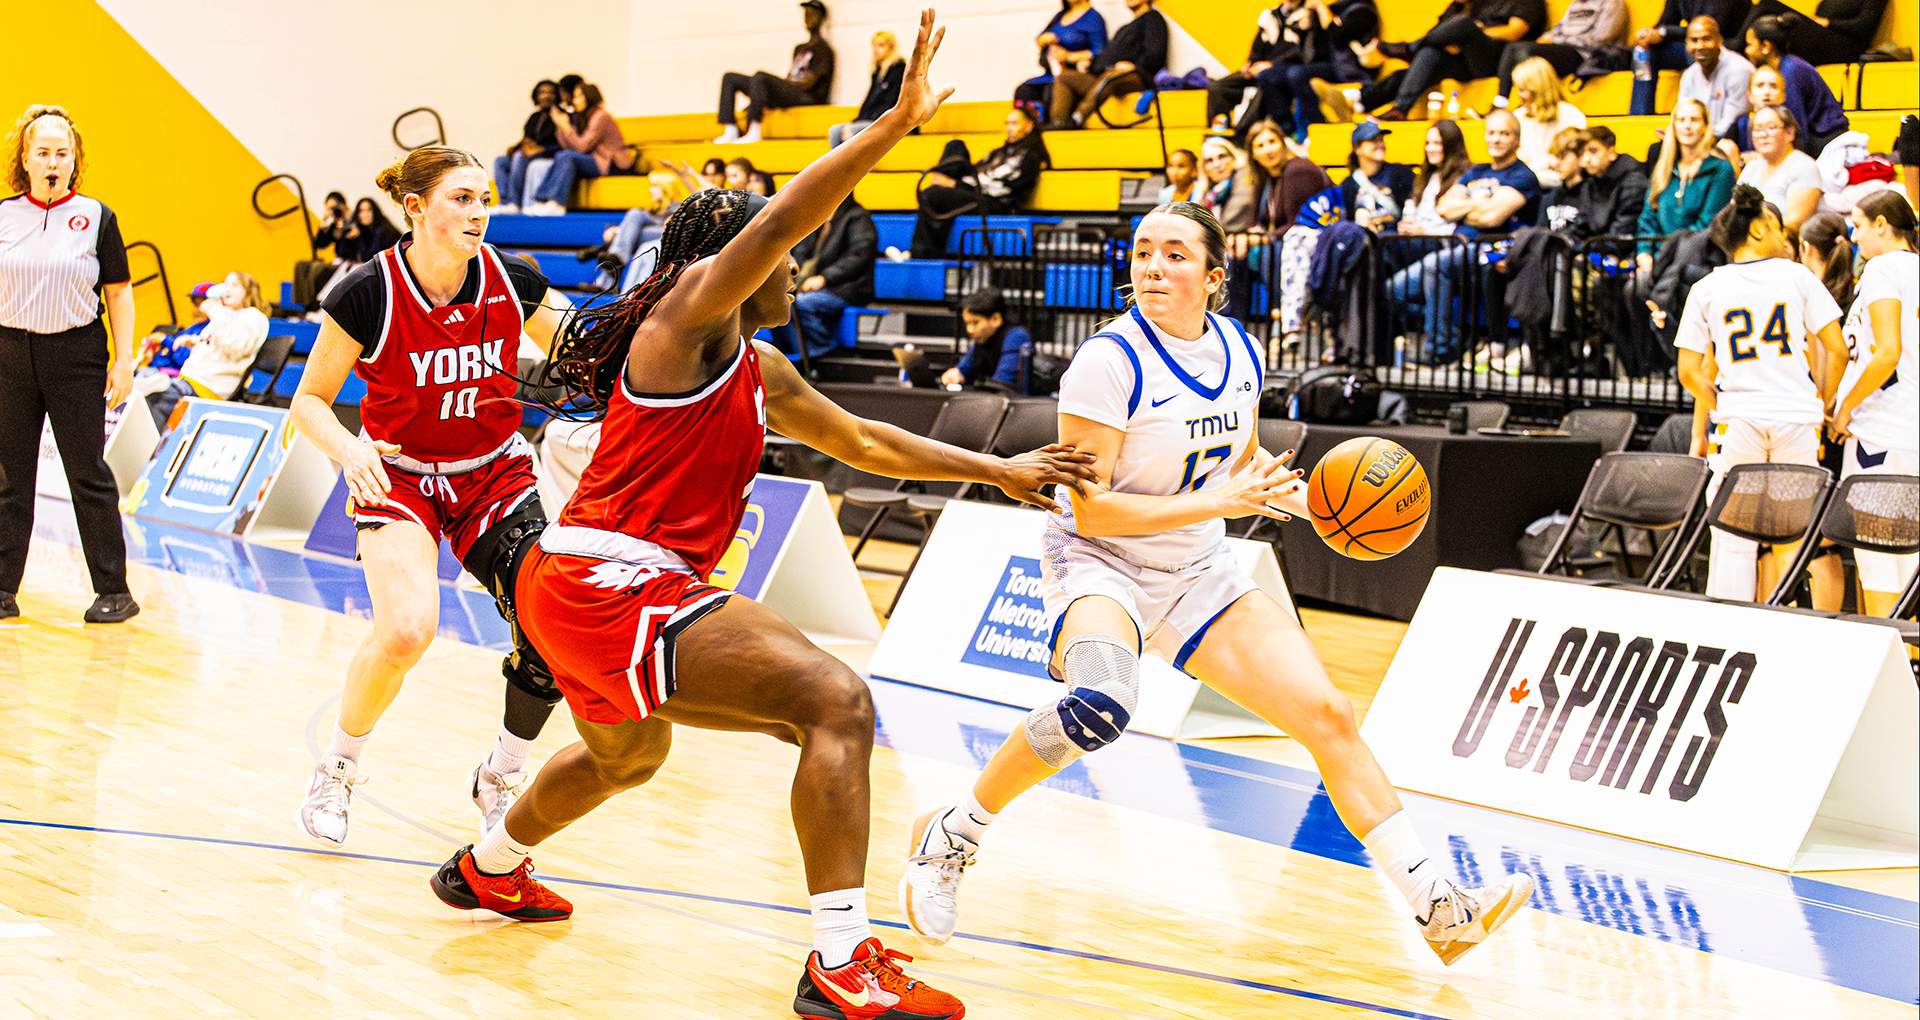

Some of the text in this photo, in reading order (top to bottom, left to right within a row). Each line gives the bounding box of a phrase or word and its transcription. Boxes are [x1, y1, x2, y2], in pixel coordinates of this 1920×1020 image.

[1723, 302, 1793, 364] 24
[407, 337, 506, 388] YORK
[438, 386, 480, 421] 10
[1185, 410, 1239, 440] TMU
[1174, 442, 1234, 493] 17
[1452, 617, 1757, 802] U SPORTS
